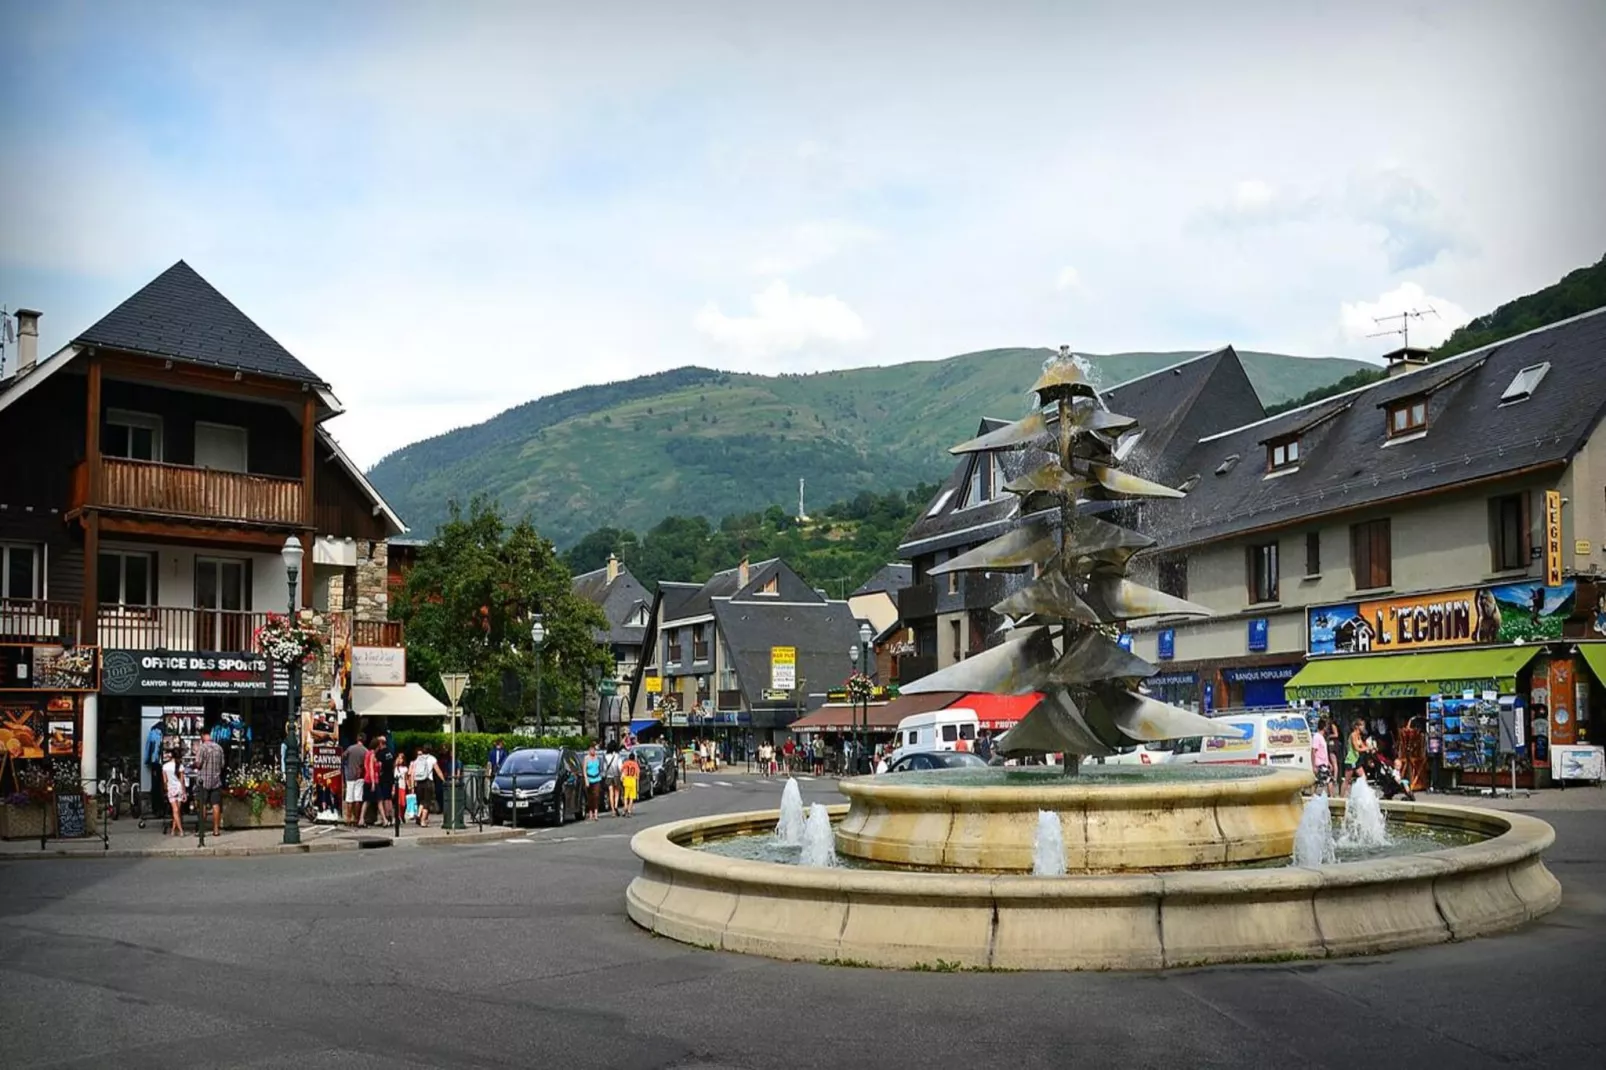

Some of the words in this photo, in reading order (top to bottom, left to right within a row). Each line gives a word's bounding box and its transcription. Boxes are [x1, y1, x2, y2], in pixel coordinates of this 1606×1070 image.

[1376, 601, 1470, 645] L'ECRIN
[141, 657, 187, 670] OFFICE
[189, 657, 216, 670] DES
[218, 659, 267, 671] SPORTS
[1234, 672, 1259, 681] BANQUE
[1260, 669, 1293, 680] POPULAIRE
[171, 680, 197, 688] RAFTING
[1295, 686, 1344, 699] CONFISERIE
[1438, 678, 1500, 695] SOUVENIRS
[313, 755, 341, 764] CANYON
